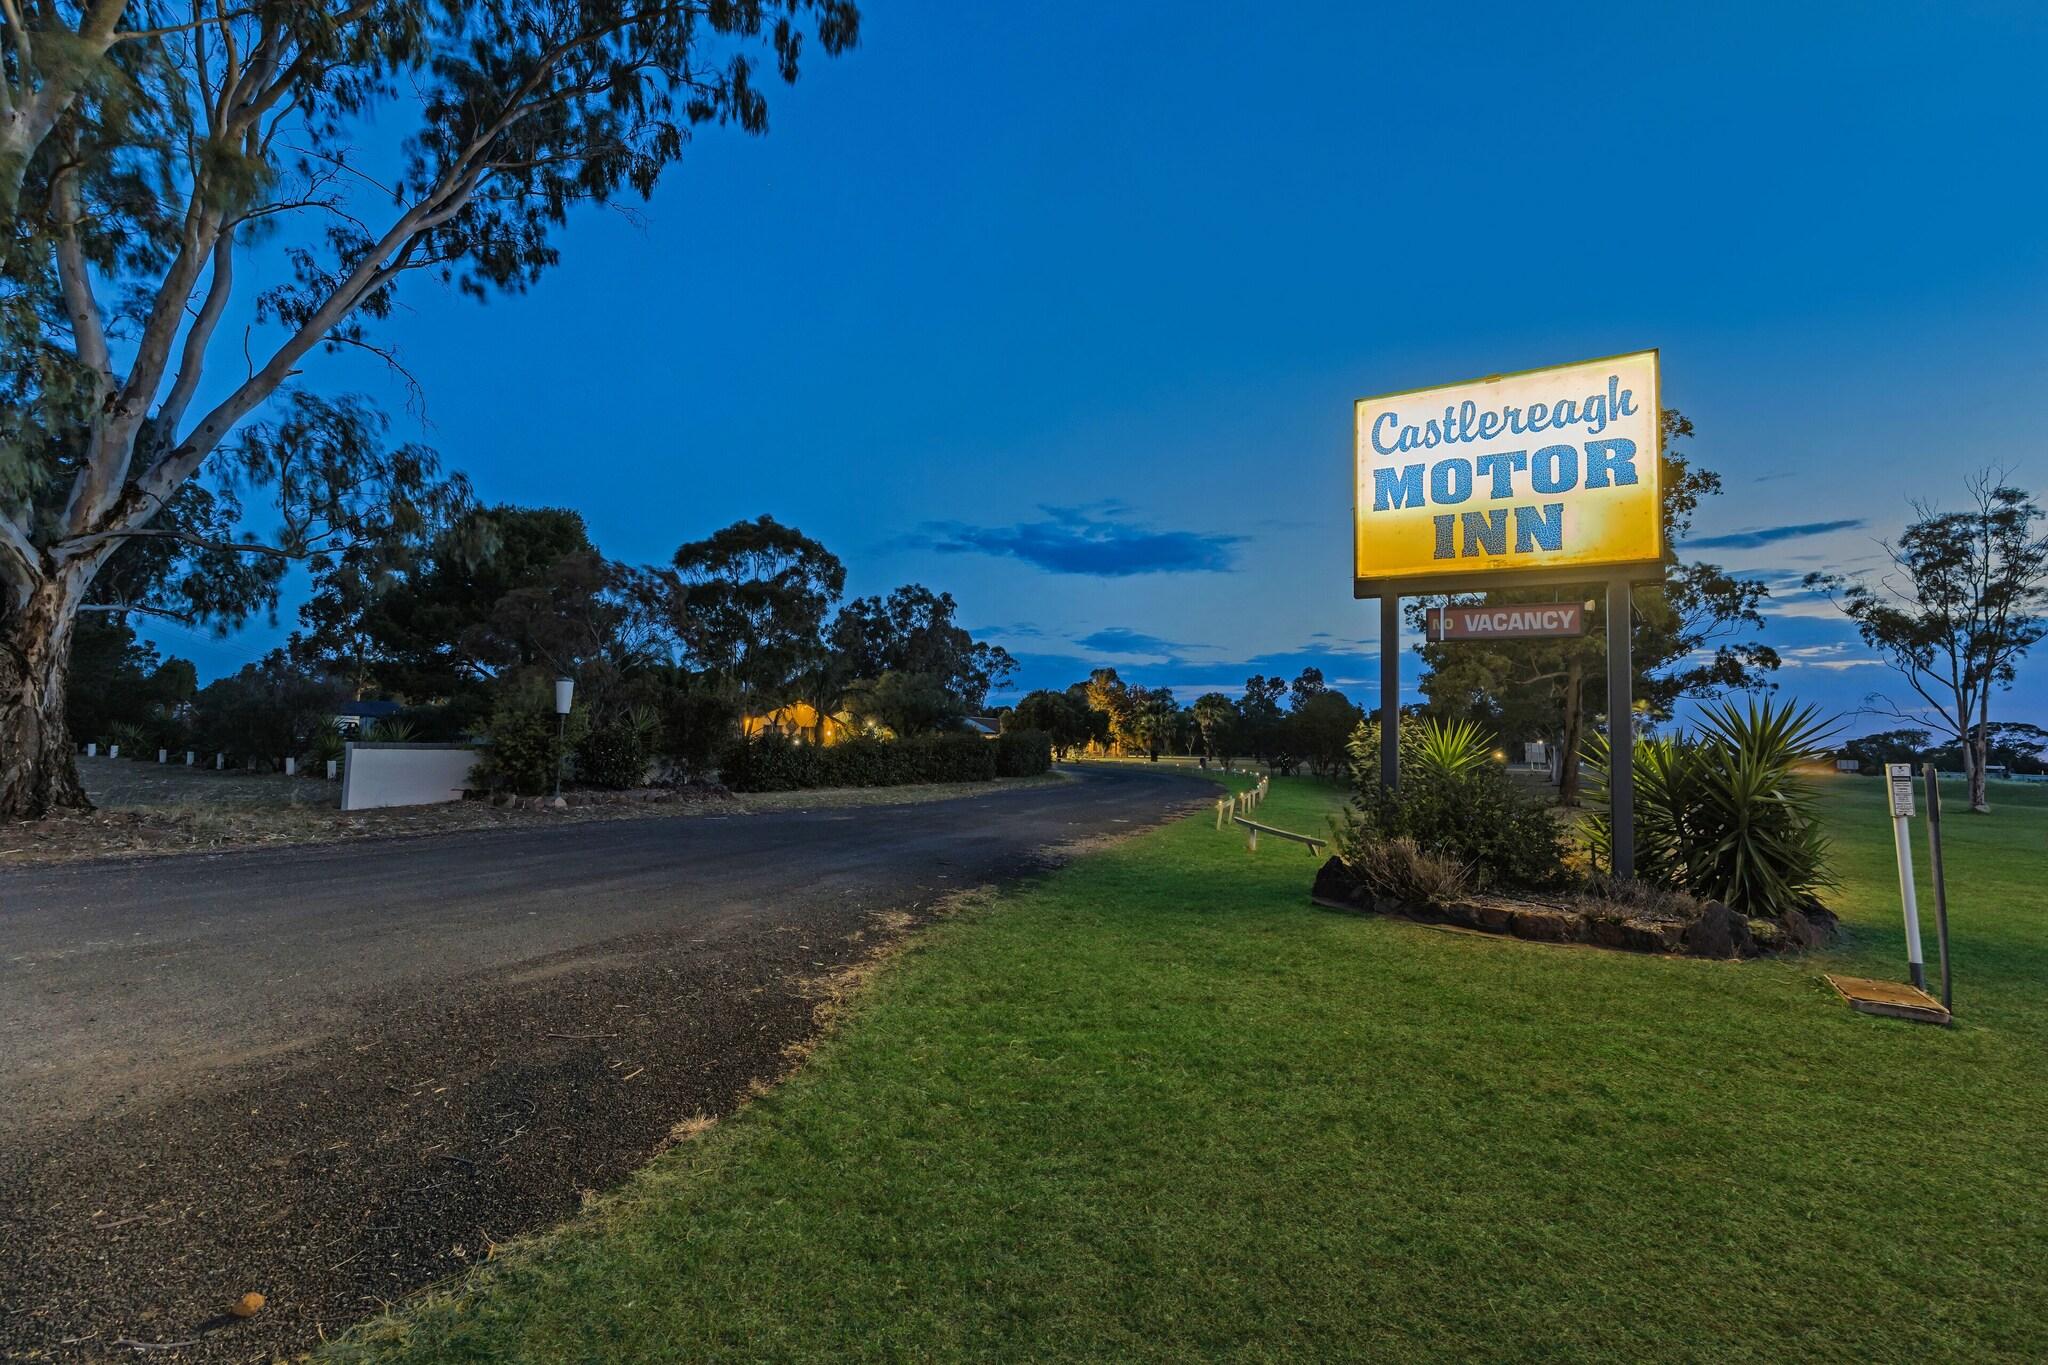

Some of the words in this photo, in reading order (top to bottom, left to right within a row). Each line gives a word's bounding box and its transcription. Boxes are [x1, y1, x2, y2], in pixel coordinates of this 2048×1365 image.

[1371, 375, 1638, 456] Castlereagh
[1373, 438, 1639, 511] MOTOR
[1433, 503, 1564, 560] INN
[1464, 610, 1575, 632] VACANCY
